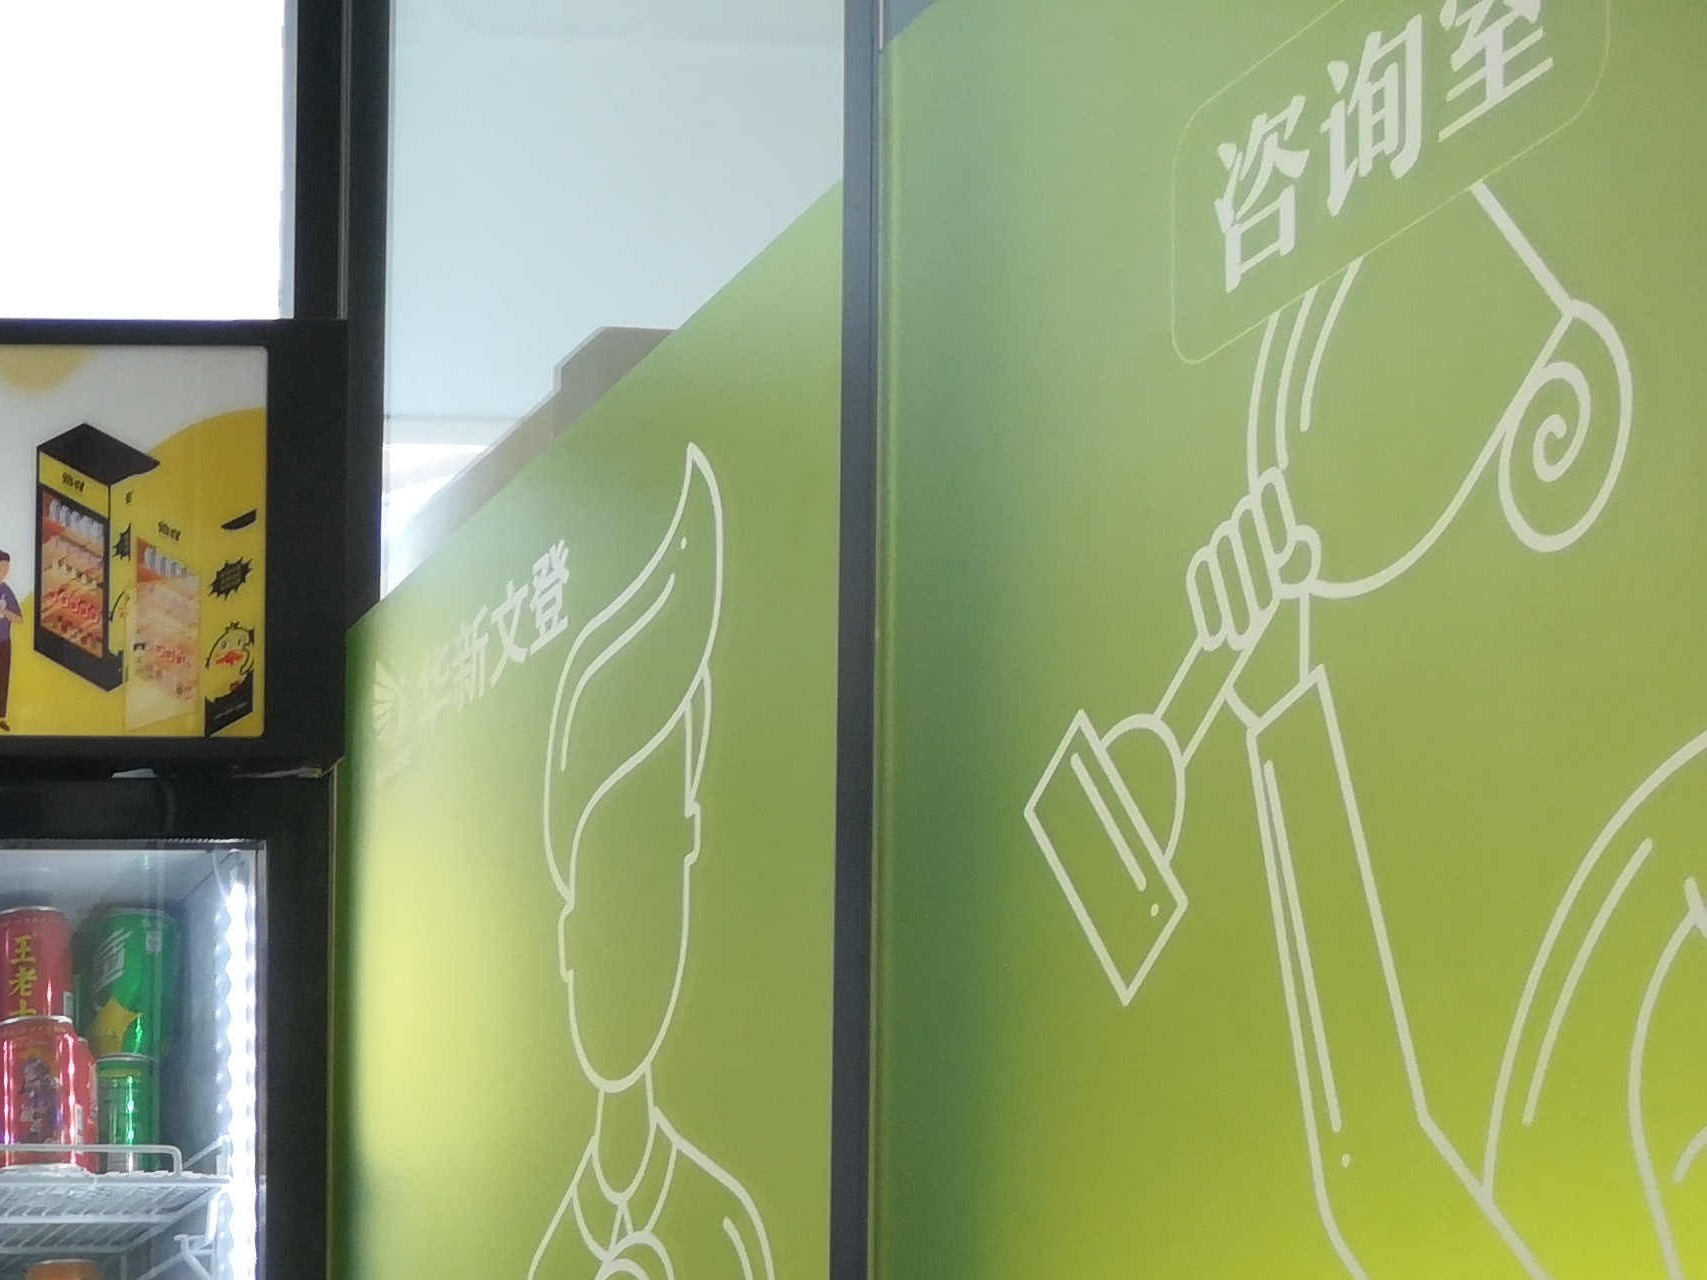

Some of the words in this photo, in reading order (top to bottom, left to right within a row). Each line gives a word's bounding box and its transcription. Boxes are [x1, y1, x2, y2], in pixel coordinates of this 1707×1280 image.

[1214, 0, 1554, 292] 咨询室
[418, 539, 569, 733] 华新文登
